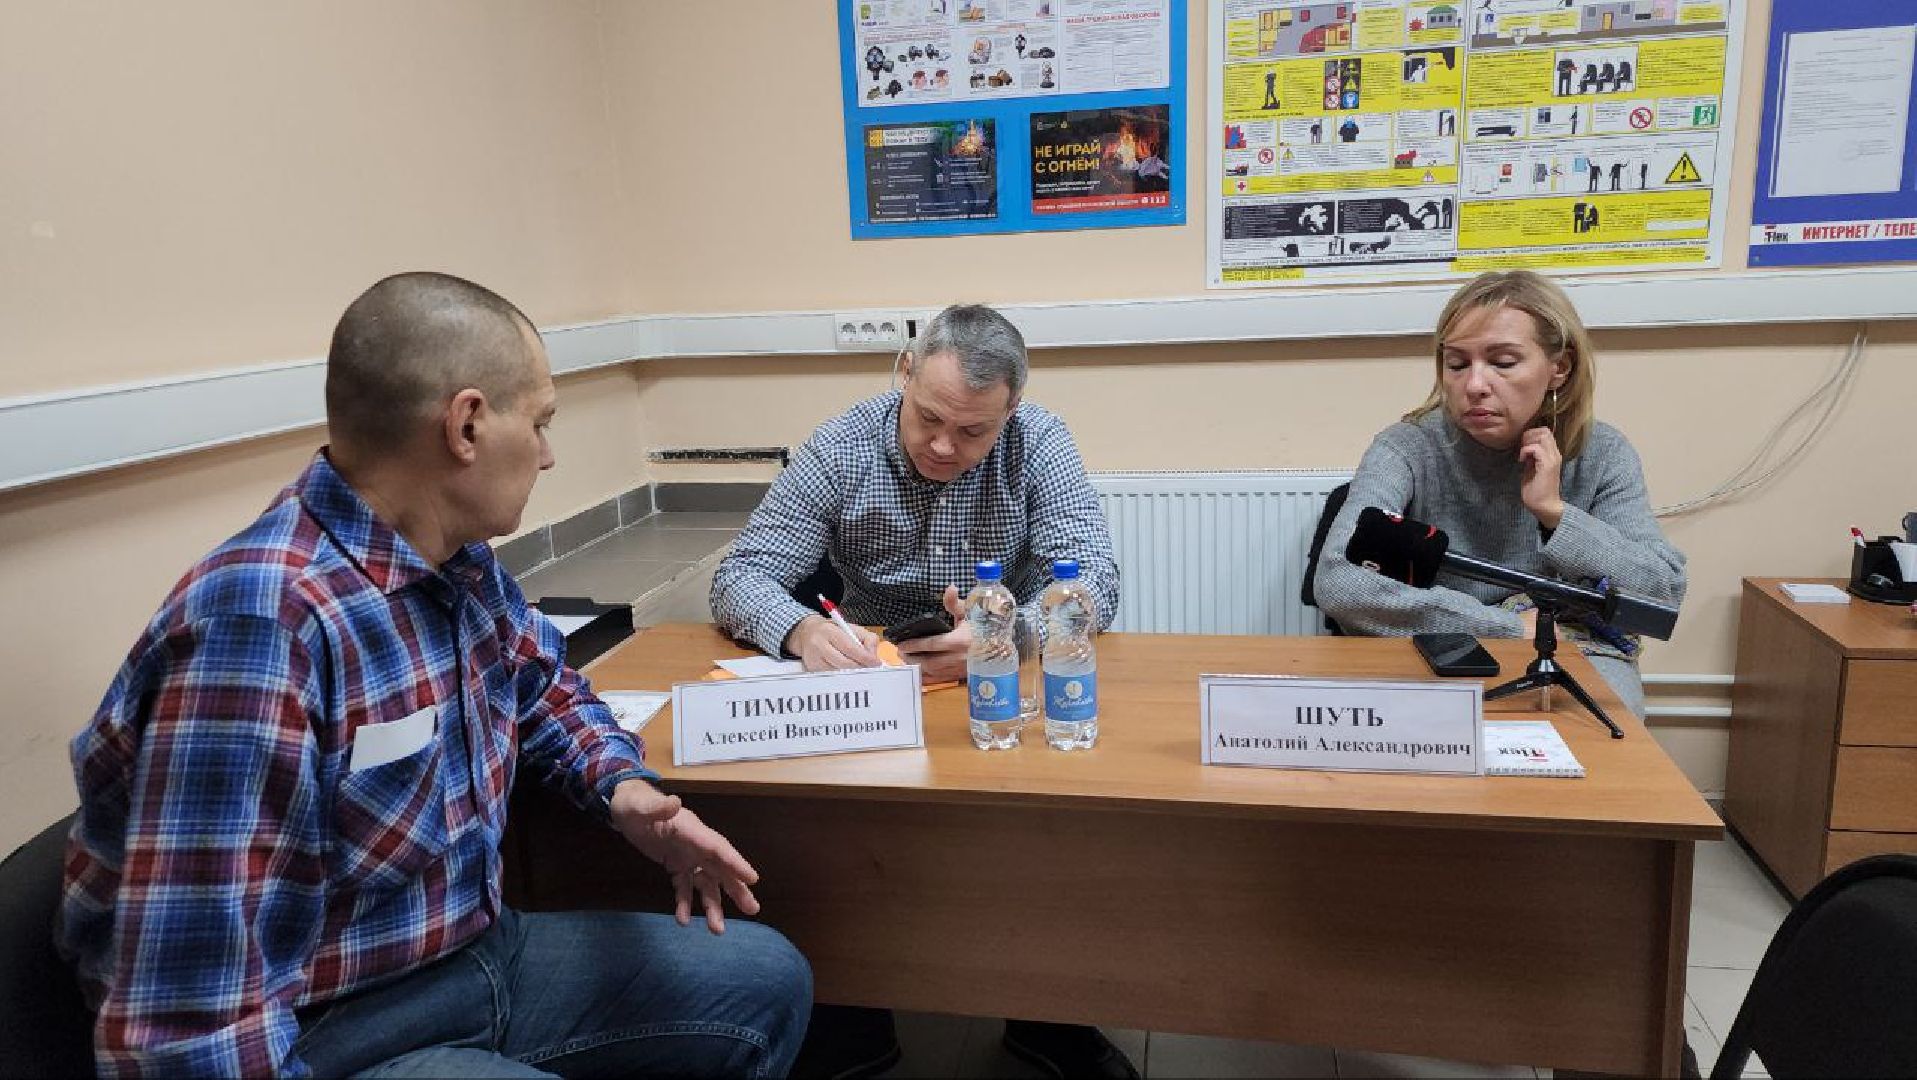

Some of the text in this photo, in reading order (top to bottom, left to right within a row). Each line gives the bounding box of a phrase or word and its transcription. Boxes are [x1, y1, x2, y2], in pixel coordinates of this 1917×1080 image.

[1035, 138, 1101, 158] НЕ ИГРАЙ
[1035, 156, 1100, 174] С ОГНЁМ!
[1802, 224, 1870, 240] ИНТЕРНЕТ
[1884, 222, 1917, 237] ТЕЛЕ
[726, 689, 872, 718] ТИМОШИН
[1295, 706, 1384, 727] ШУТЬ
[701, 719, 898, 746] Алексей Викторович
[1214, 733, 1471, 759] Анатолий Александрович
